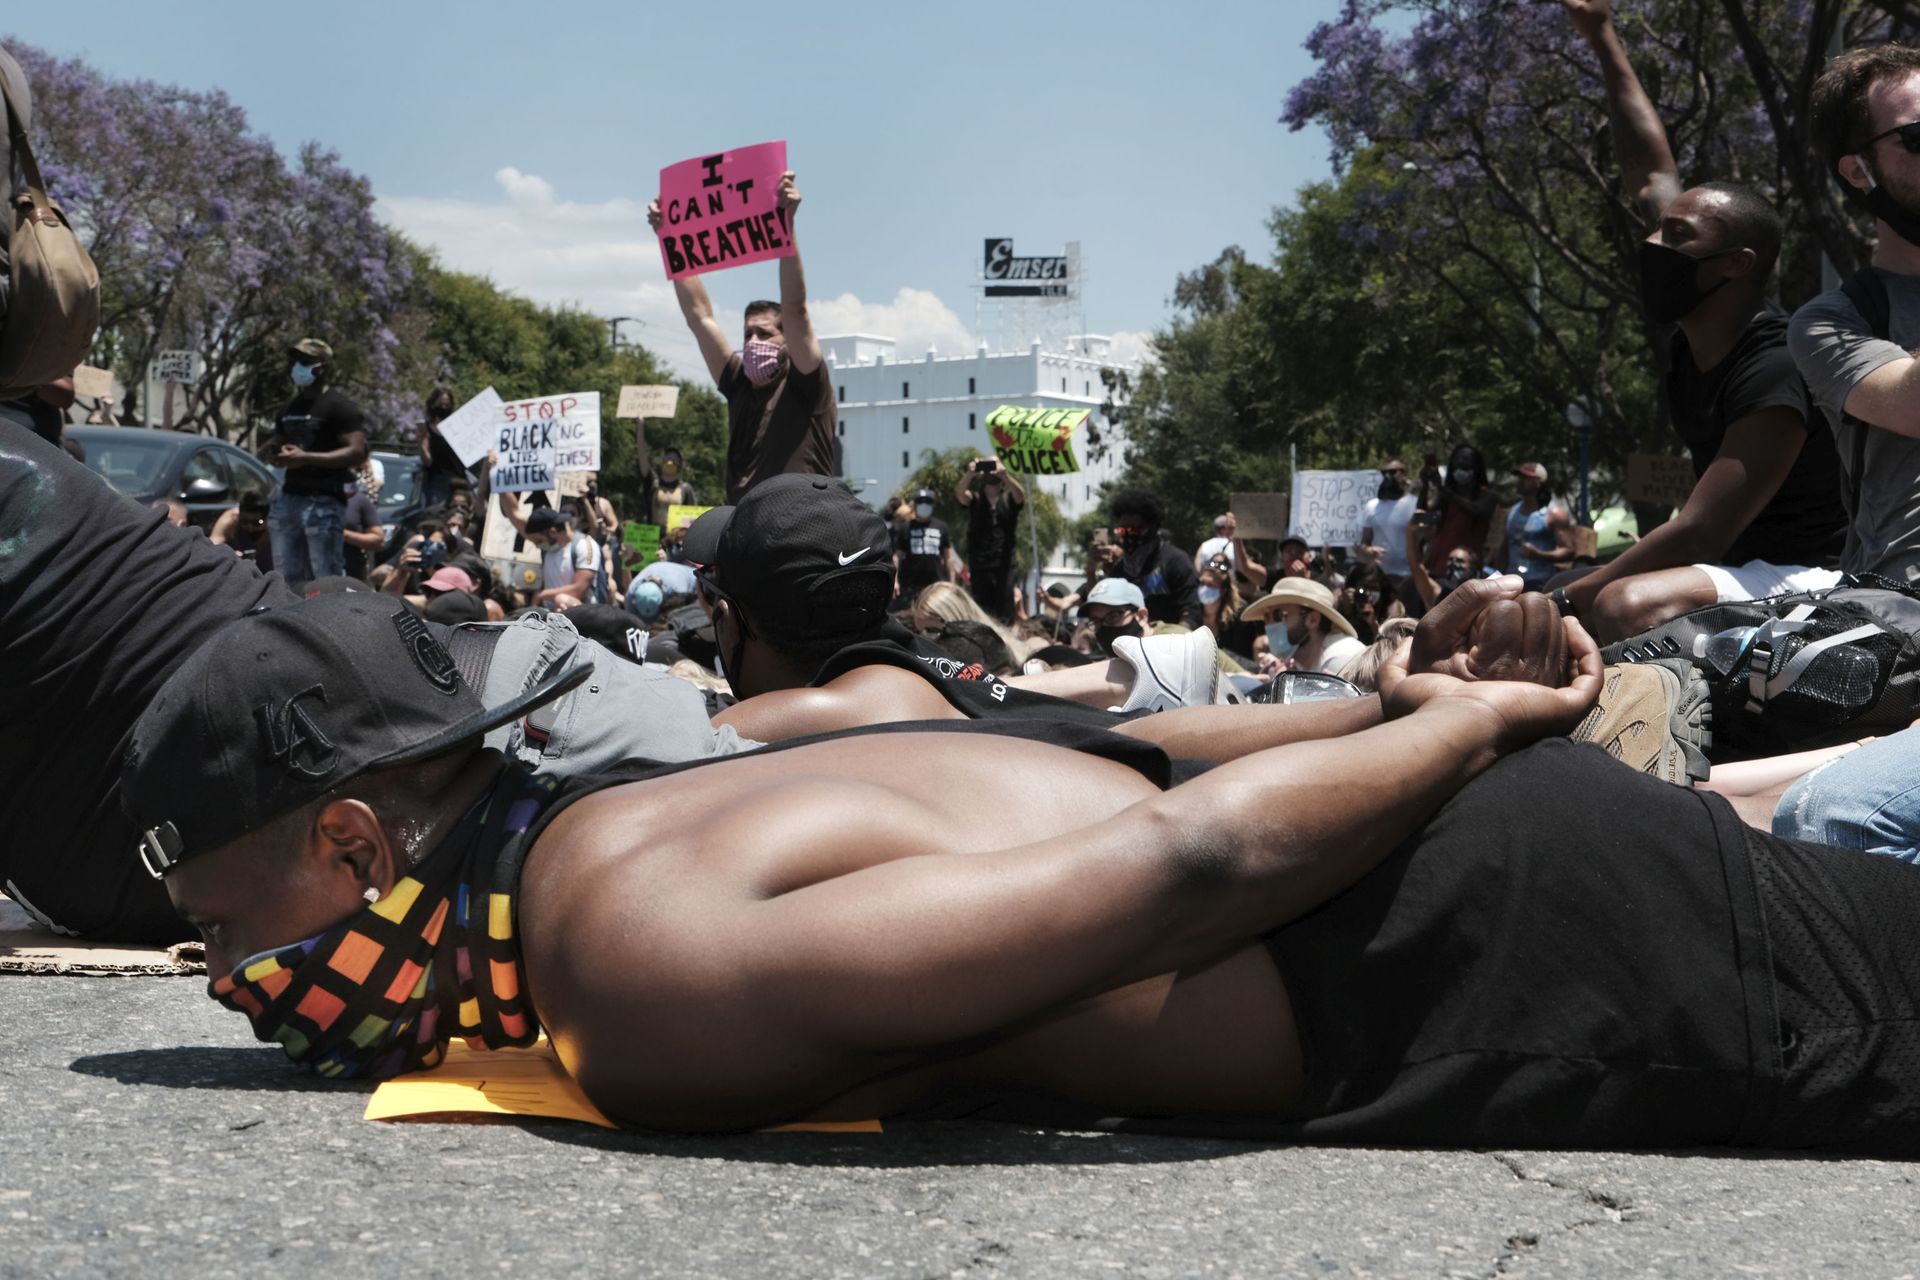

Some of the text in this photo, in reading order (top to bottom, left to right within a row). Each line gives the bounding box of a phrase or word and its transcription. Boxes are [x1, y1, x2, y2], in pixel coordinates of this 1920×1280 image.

[702, 154, 724, 188] I
[668, 179, 753, 225] CAN'T
[663, 206, 791, 274] BREATHE!
[985, 240, 1067, 279] Emser
[504, 397, 577, 422] STOP
[990, 408, 1083, 429] POLICE
[500, 422, 553, 452] BLACK
[509, 451, 539, 463] LIVES
[996, 447, 1076, 475] POLICE!
[496, 463, 550, 486] MATTER
[1303, 477, 1354, 501] STOP
[1309, 501, 1358, 520] Police
